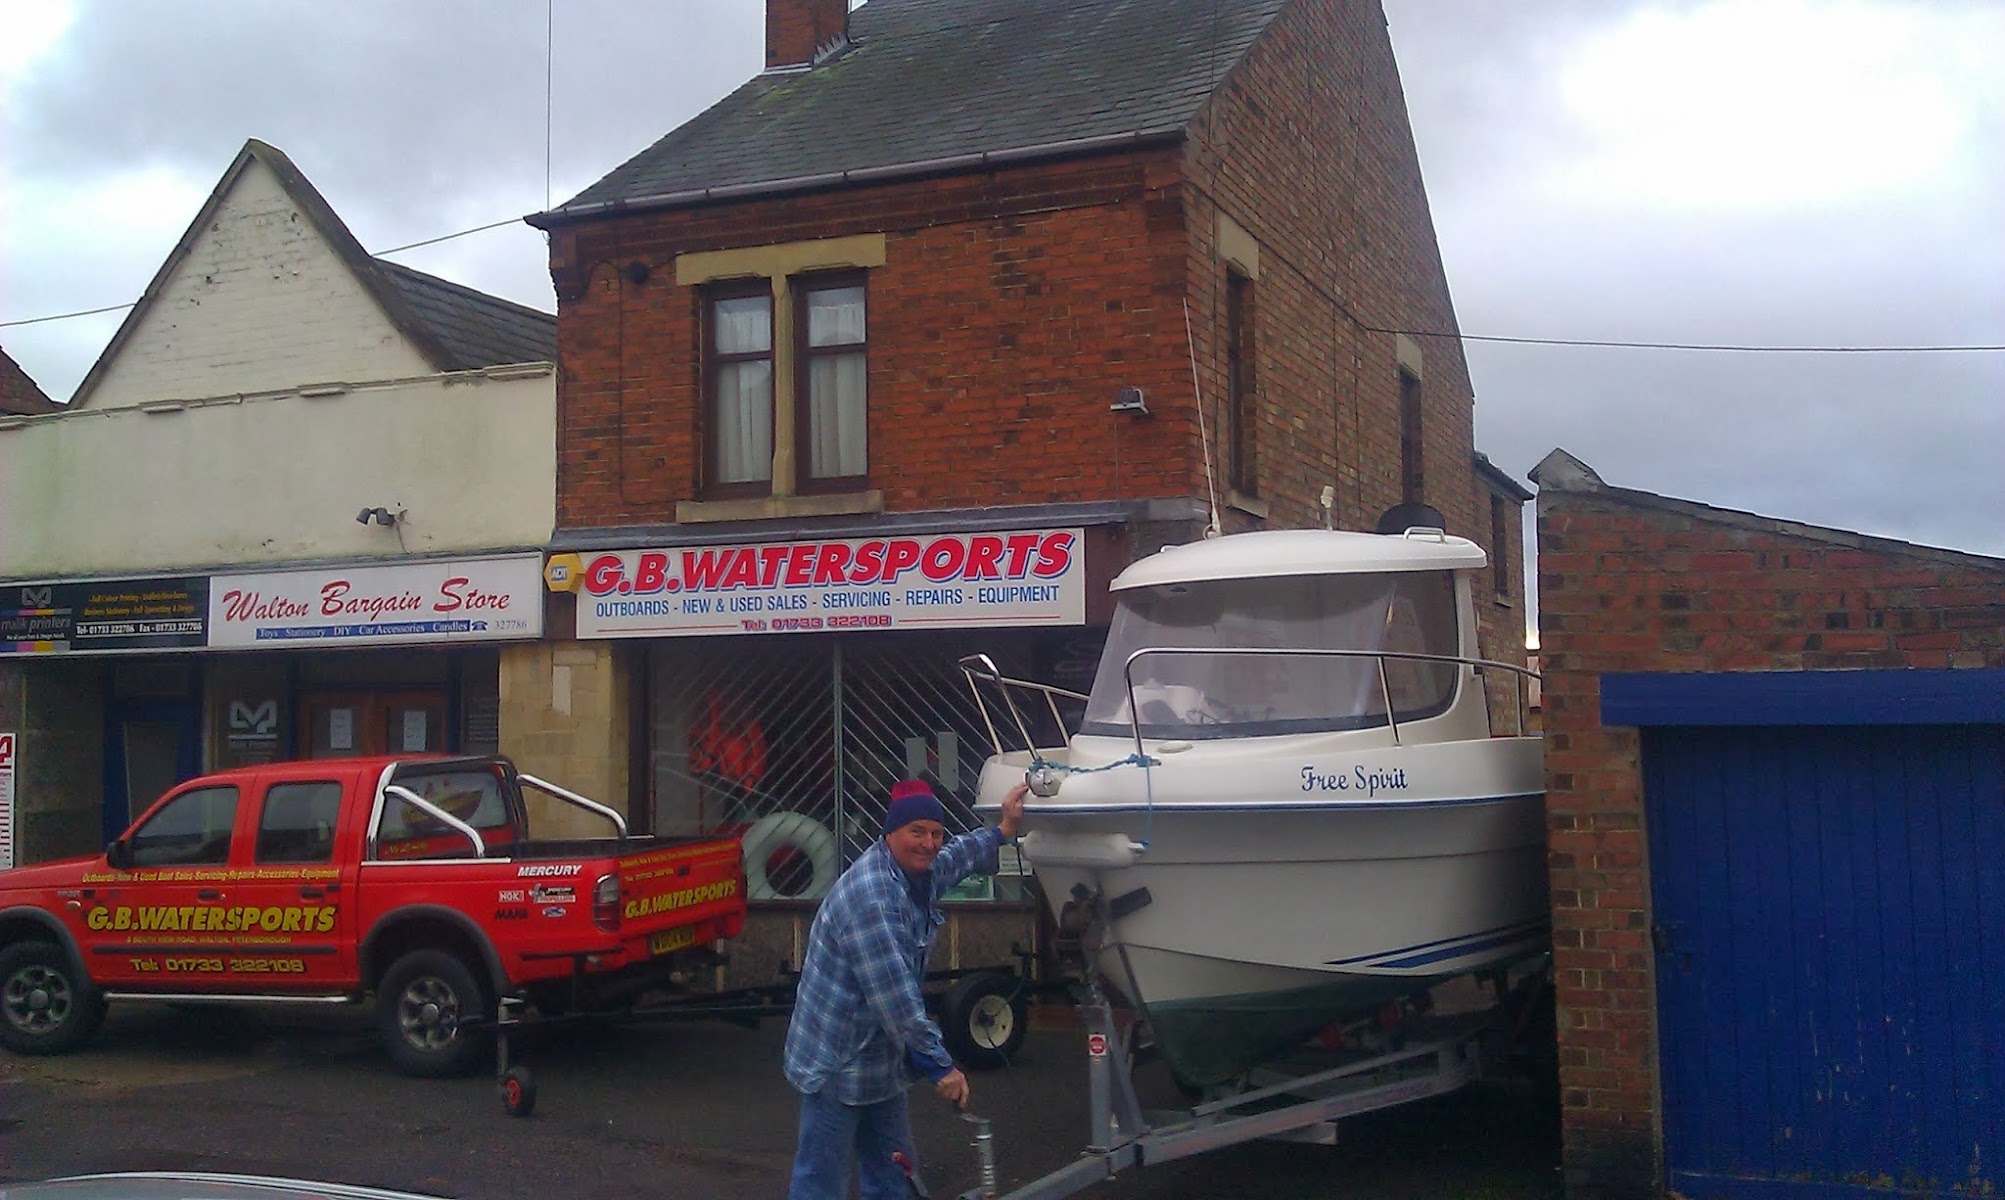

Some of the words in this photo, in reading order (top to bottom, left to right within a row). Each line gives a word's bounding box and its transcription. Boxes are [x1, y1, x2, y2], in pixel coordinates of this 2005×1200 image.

[551, 568, 567, 579] ADT
[584, 531, 1076, 597] G.B.WATERSPORTS
[223, 590, 309, 622] Walton
[321, 580, 421, 622] Bargain
[433, 577, 510, 612] Store
[596, 600, 669, 617] OUTBOARDS
[683, 599, 711, 614] NEW
[716, 600, 725, 612] &
[730, 597, 763, 612] USED
[768, 594, 807, 611] SALES
[823, 591, 891, 609] SERVICING
[906, 588, 963, 605] REPAIRS
[979, 585, 1060, 603] EQUIPMENT
[259, 629, 279, 641] Toys
[285, 628, 326, 639] Stationery
[333, 626, 351, 636] DIY
[358, 625, 375, 635] Car
[375, 623, 425, 635] Accessories
[432, 621, 468, 632] Candles
[771, 617, 823, 629] 01733
[828, 615, 892, 628] 322108
[1301, 766, 1349, 791] Free
[1354, 764, 1408, 797] Spirit
[517, 864, 582, 877] MERCURY
[87, 906, 337, 932] G.B.WATERSPORTS
[165, 958, 224, 972] 01733
[229, 958, 305, 973] 322108
